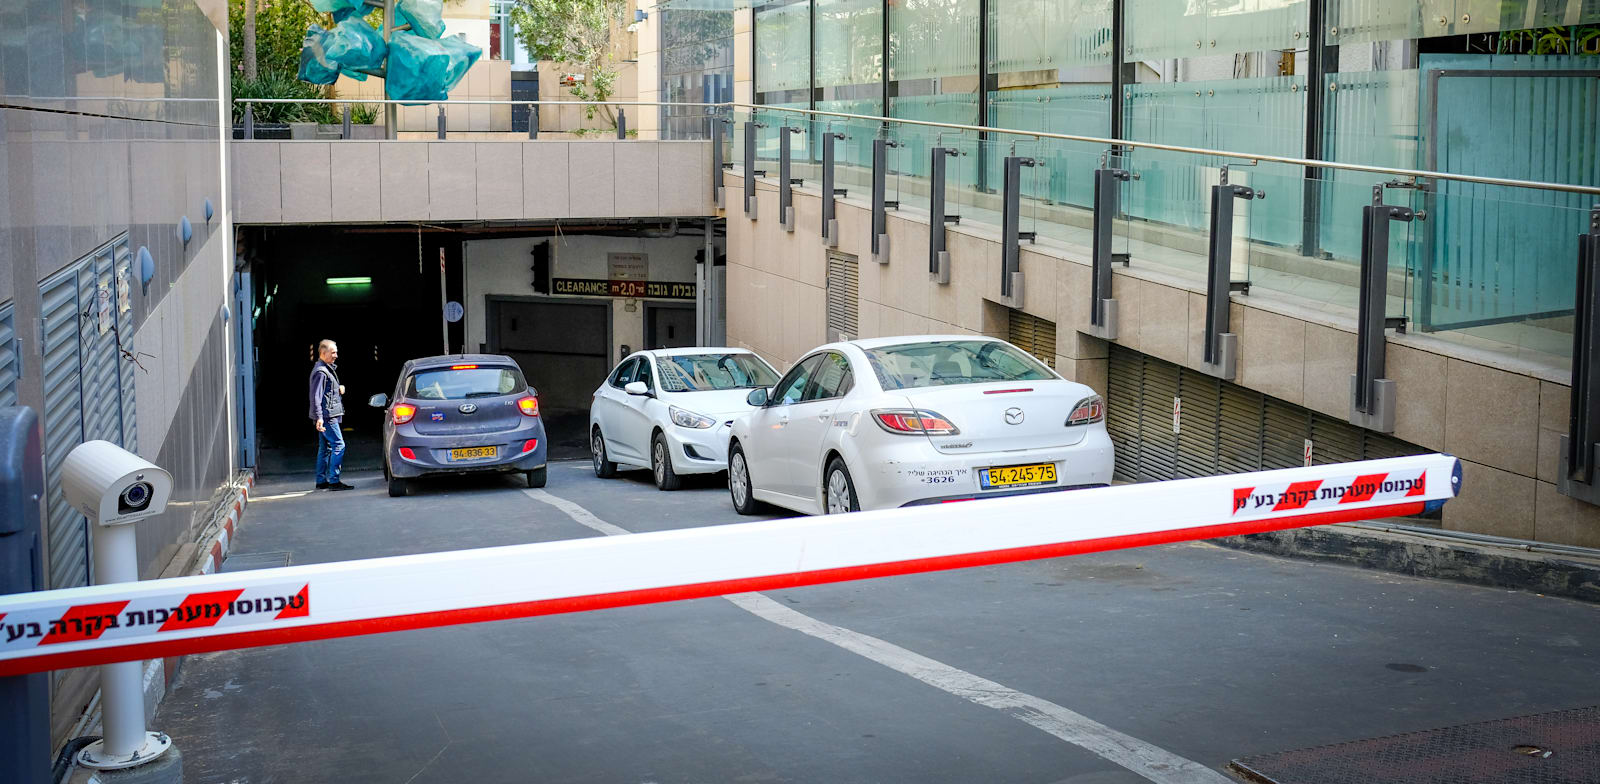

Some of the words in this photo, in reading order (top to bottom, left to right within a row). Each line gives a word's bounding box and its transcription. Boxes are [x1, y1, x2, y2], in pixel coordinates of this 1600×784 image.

[556, 281, 608, 294] CLEARANCE
[620, 282, 635, 296] 2.0
[648, 283, 669, 296] גובה
[672, 284, 696, 297] גבלת
[1278, 489, 1317, 507] בקרה
[1321, 483, 1377, 500] מערכות
[1236, 494, 1275, 510] בע"מ
[125, 602, 222, 628] מערכות
[49, 613, 120, 637] בקרה
